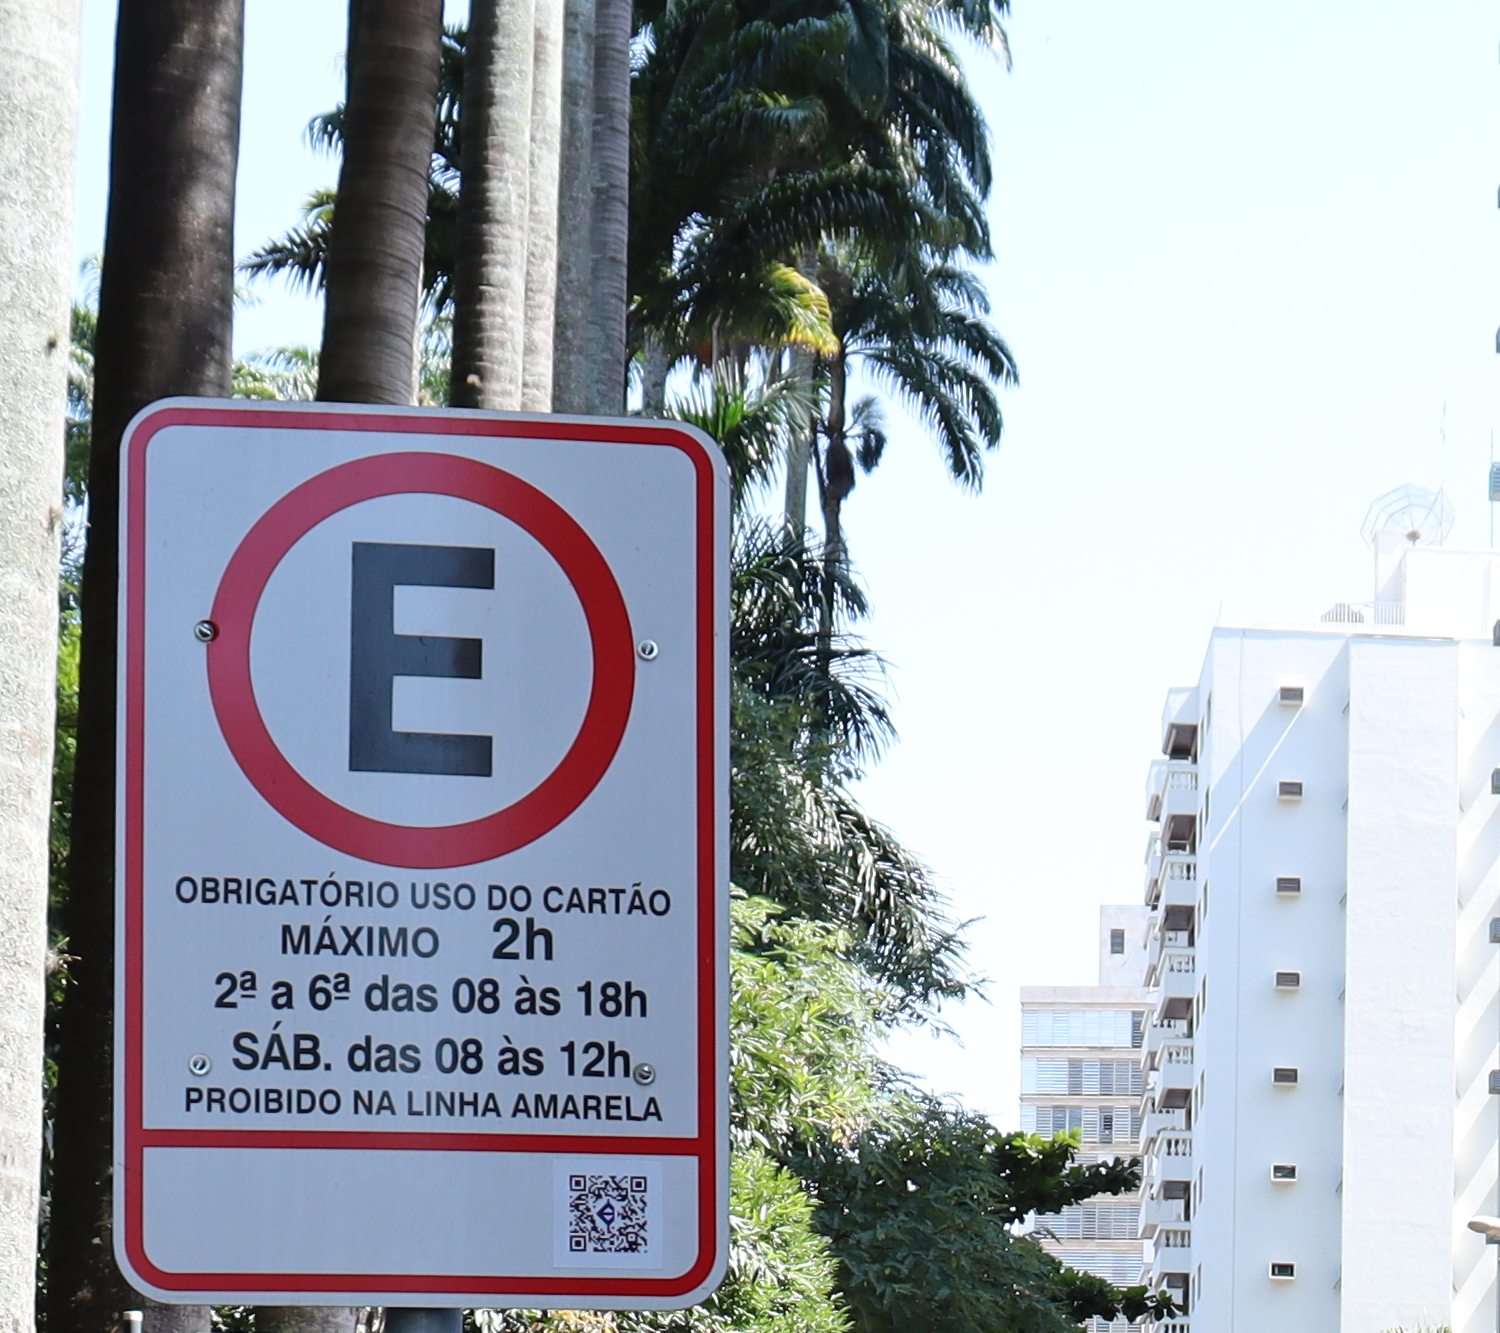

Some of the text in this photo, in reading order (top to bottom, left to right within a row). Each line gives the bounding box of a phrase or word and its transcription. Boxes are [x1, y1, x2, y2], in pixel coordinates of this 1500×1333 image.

[348, 541, 496, 778] E
[174, 871, 672, 917] OBRIGATÓRIO USO DO CARTÃO
[280, 915, 554, 961] MÁXIMO 2h
[270, 977, 295, 1010] a
[364, 974, 439, 1013] das
[451, 977, 501, 1015] 08
[514, 975, 562, 1016] às
[576, 981, 649, 1018] 18h
[231, 1021, 631, 1078] SÁB. das 08 às 12h
[184, 1087, 664, 1122] PROIBIDO NA LINHA AMARELA
